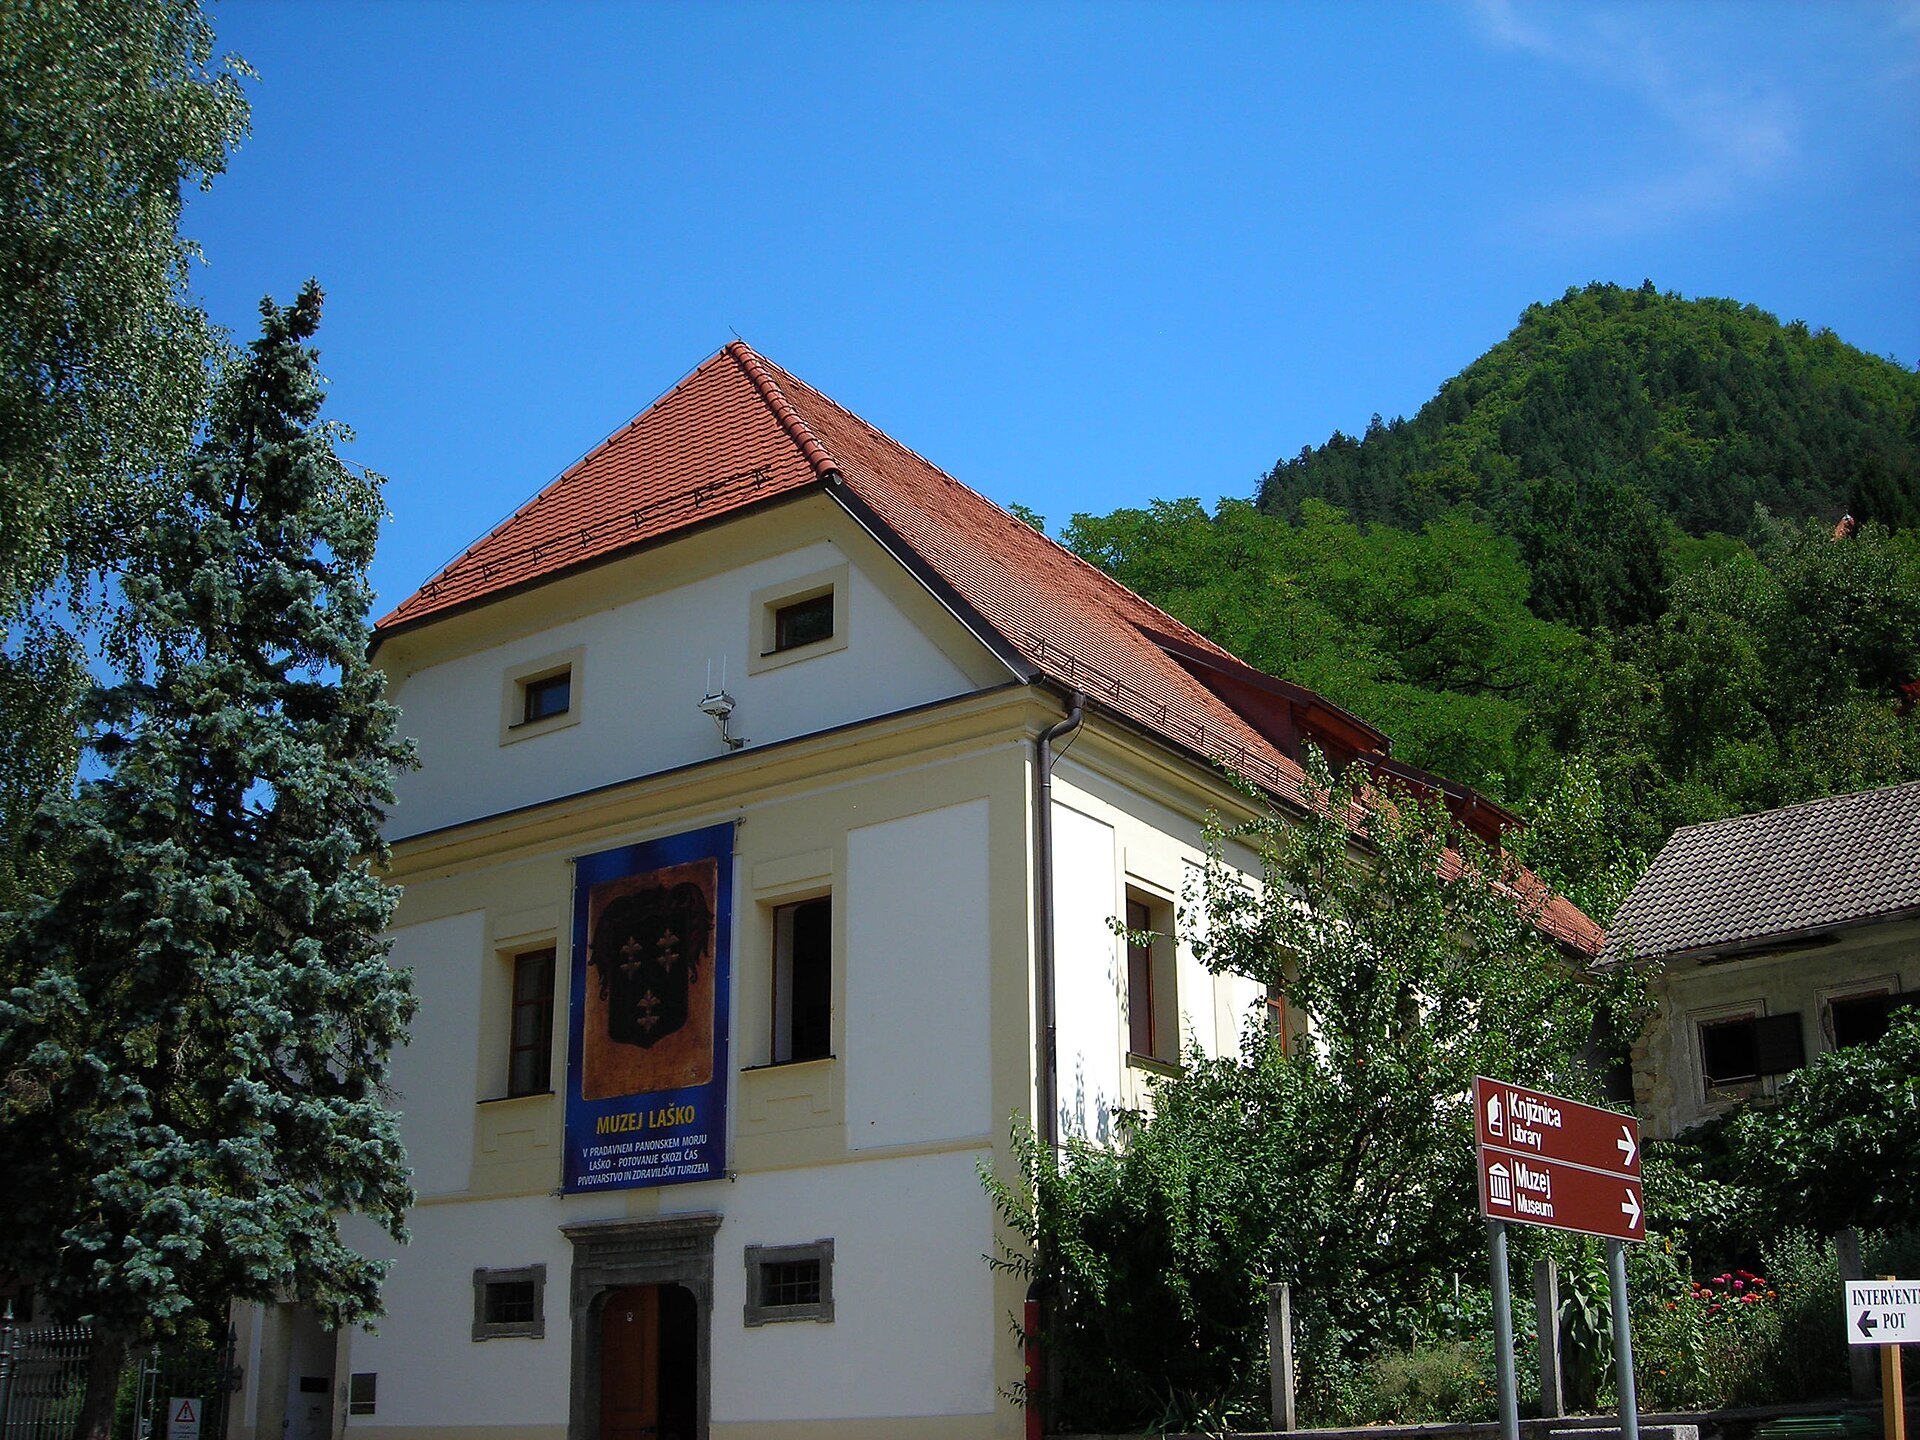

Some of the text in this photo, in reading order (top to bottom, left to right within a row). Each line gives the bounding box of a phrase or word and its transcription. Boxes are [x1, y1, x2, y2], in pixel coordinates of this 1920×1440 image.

[596, 1102, 696, 1135] MUZEJ LAŠKO
[1509, 1091, 1562, 1128] Knjižnica
[582, 1134, 708, 1158] V PRADAVNEM PANONSKEM MORJU
[1511, 1122, 1542, 1151] Library
[589, 1158, 611, 1171] LAŠKO
[618, 1153, 659, 1168] POTOVANJE
[661, 1151, 682, 1163] SKOZI
[684, 1148, 698, 1161] ČAS
[577, 1162, 709, 1186] PIVOVARSTVO IN ZDRAVILIŠKI TURIZEM
[1515, 1161, 1551, 1200] Muzej
[1517, 1192, 1554, 1218] Museum
[1882, 1312, 1906, 1329] POT
